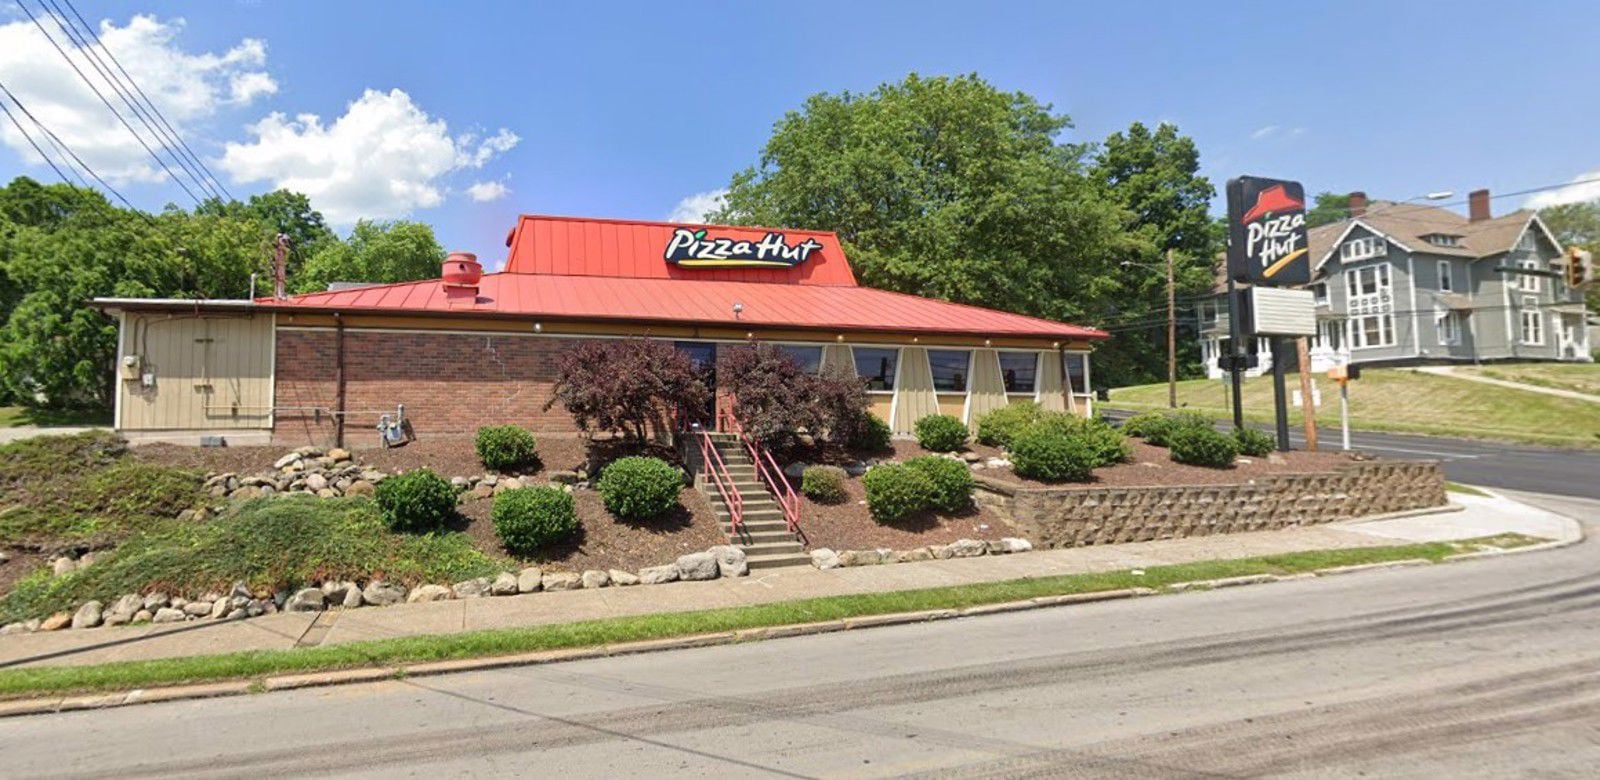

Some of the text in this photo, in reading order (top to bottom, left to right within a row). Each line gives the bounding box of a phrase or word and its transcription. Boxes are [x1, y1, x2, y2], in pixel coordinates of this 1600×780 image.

[665, 229, 822, 260] Pizza Hut
[1247, 211, 1306, 258] Pizza
[1258, 232, 1303, 267] Hut
